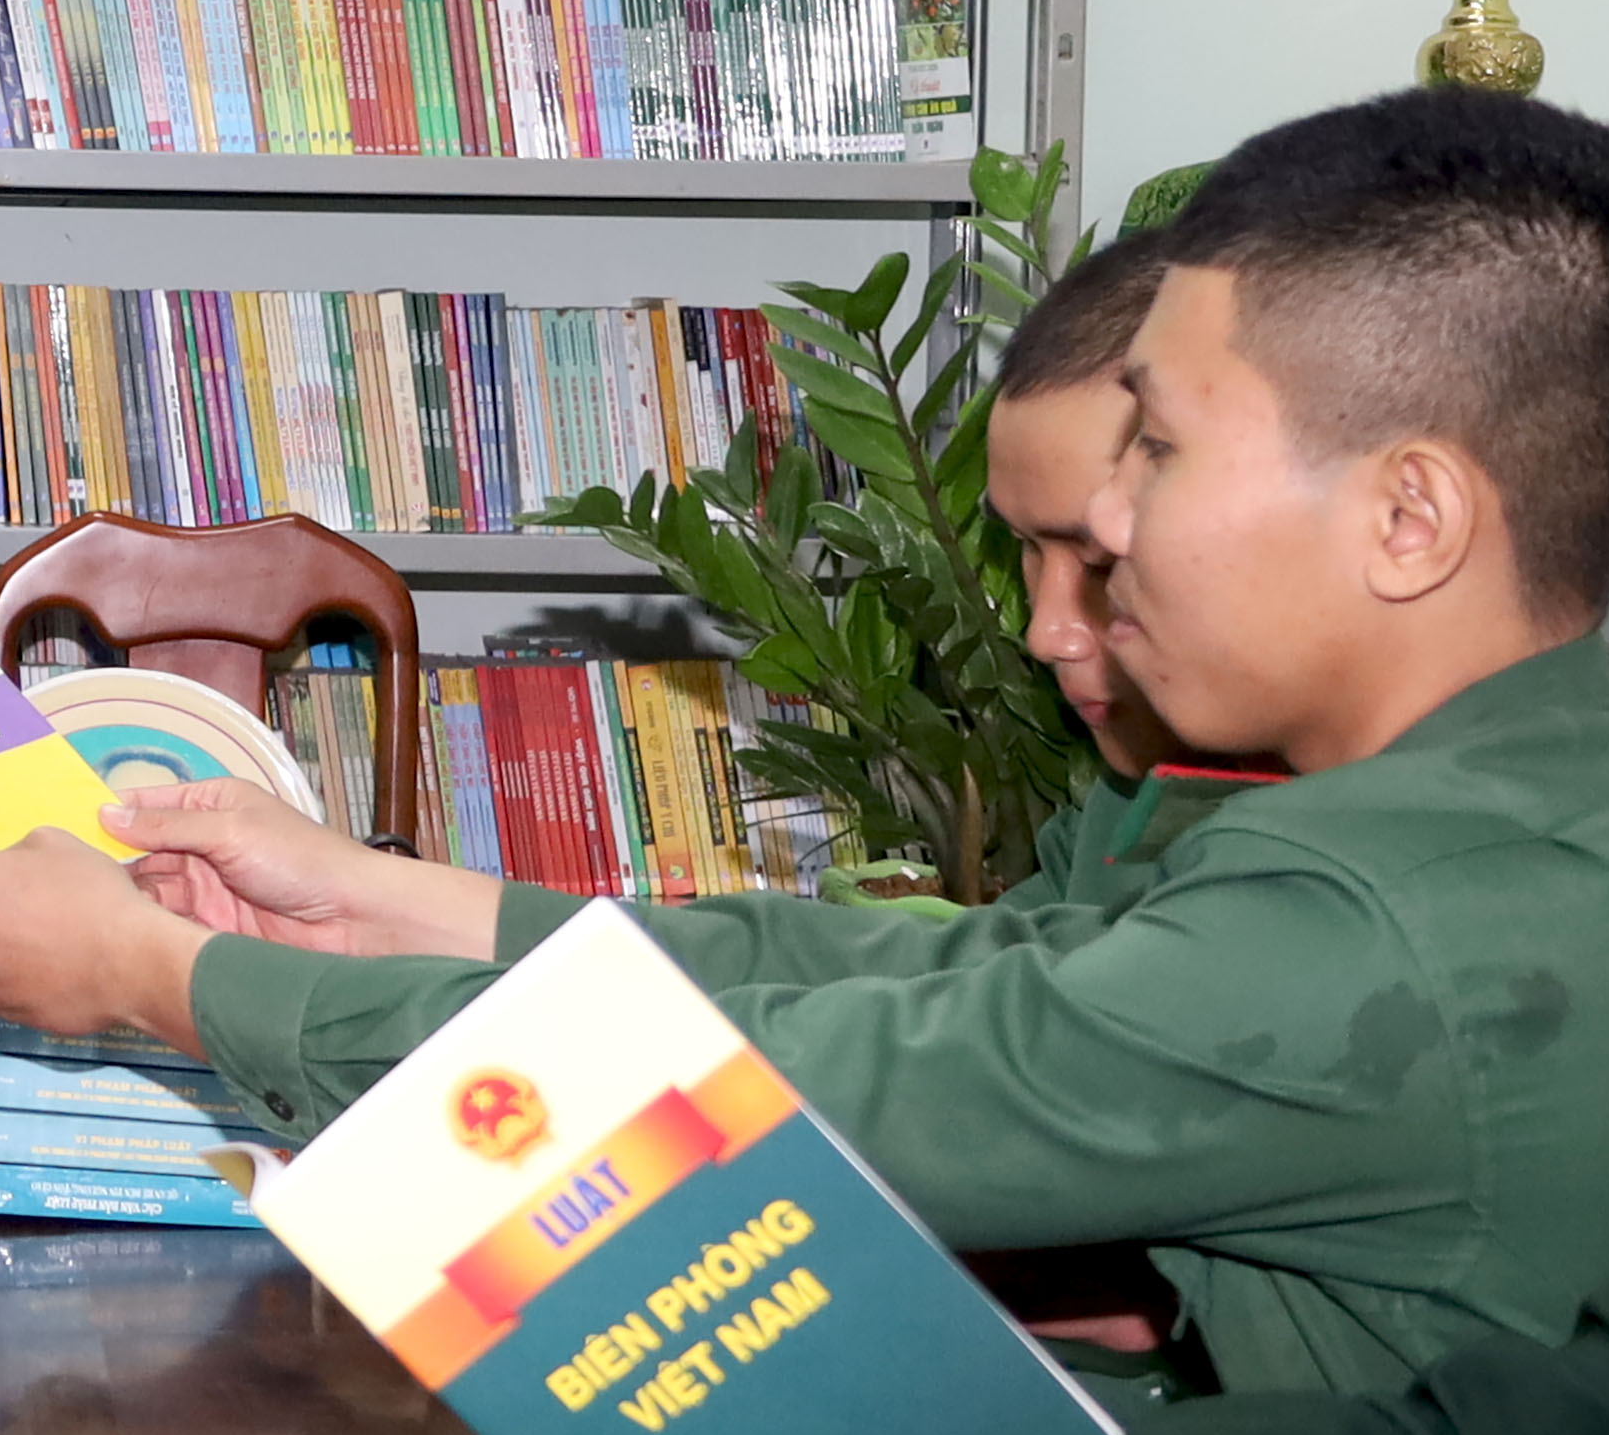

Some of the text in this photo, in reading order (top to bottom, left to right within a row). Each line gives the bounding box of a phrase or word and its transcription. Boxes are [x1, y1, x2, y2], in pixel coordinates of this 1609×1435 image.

[531, 1157, 631, 1250] LUẬT
[544, 1199, 816, 1412] BIÊN PHÒNG
[618, 1267, 832, 1433] VIỆT NAM
